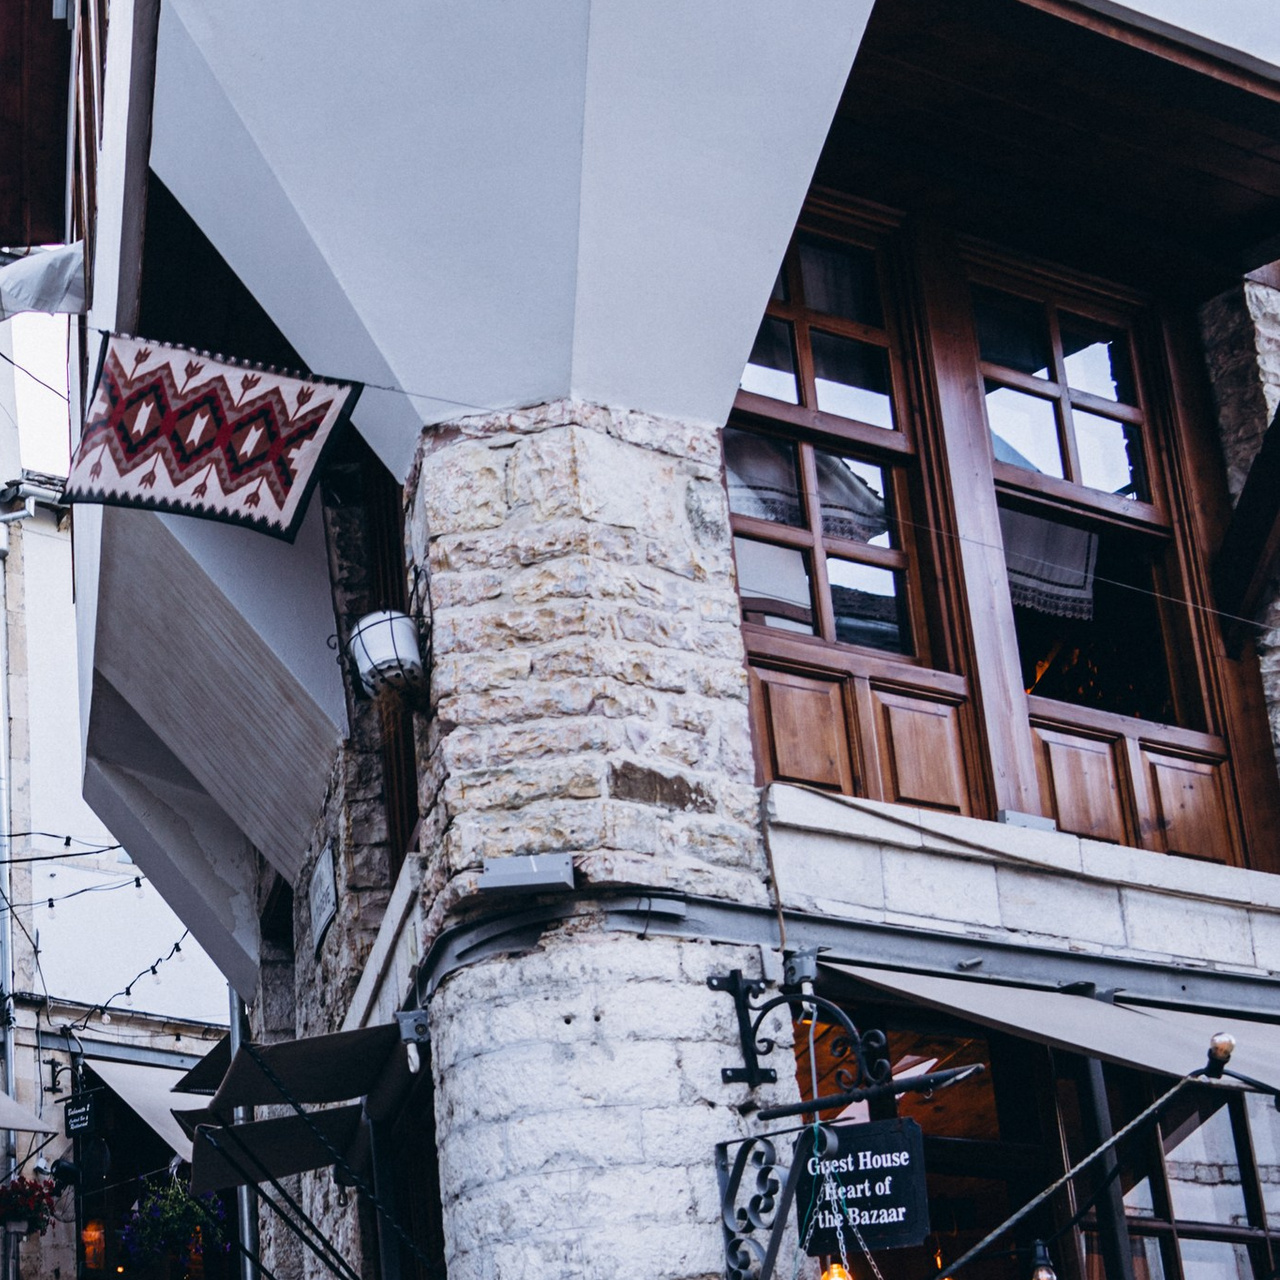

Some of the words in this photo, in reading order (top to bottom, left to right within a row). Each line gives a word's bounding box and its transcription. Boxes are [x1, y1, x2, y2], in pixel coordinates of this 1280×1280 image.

[807, 1152, 854, 1176] Guest
[858, 1149, 910, 1170] House
[824, 1180, 871, 1201] Heart
[875, 1176, 893, 1195] of
[818, 1209, 844, 1228] the
[848, 1205, 907, 1225] Bazaar
